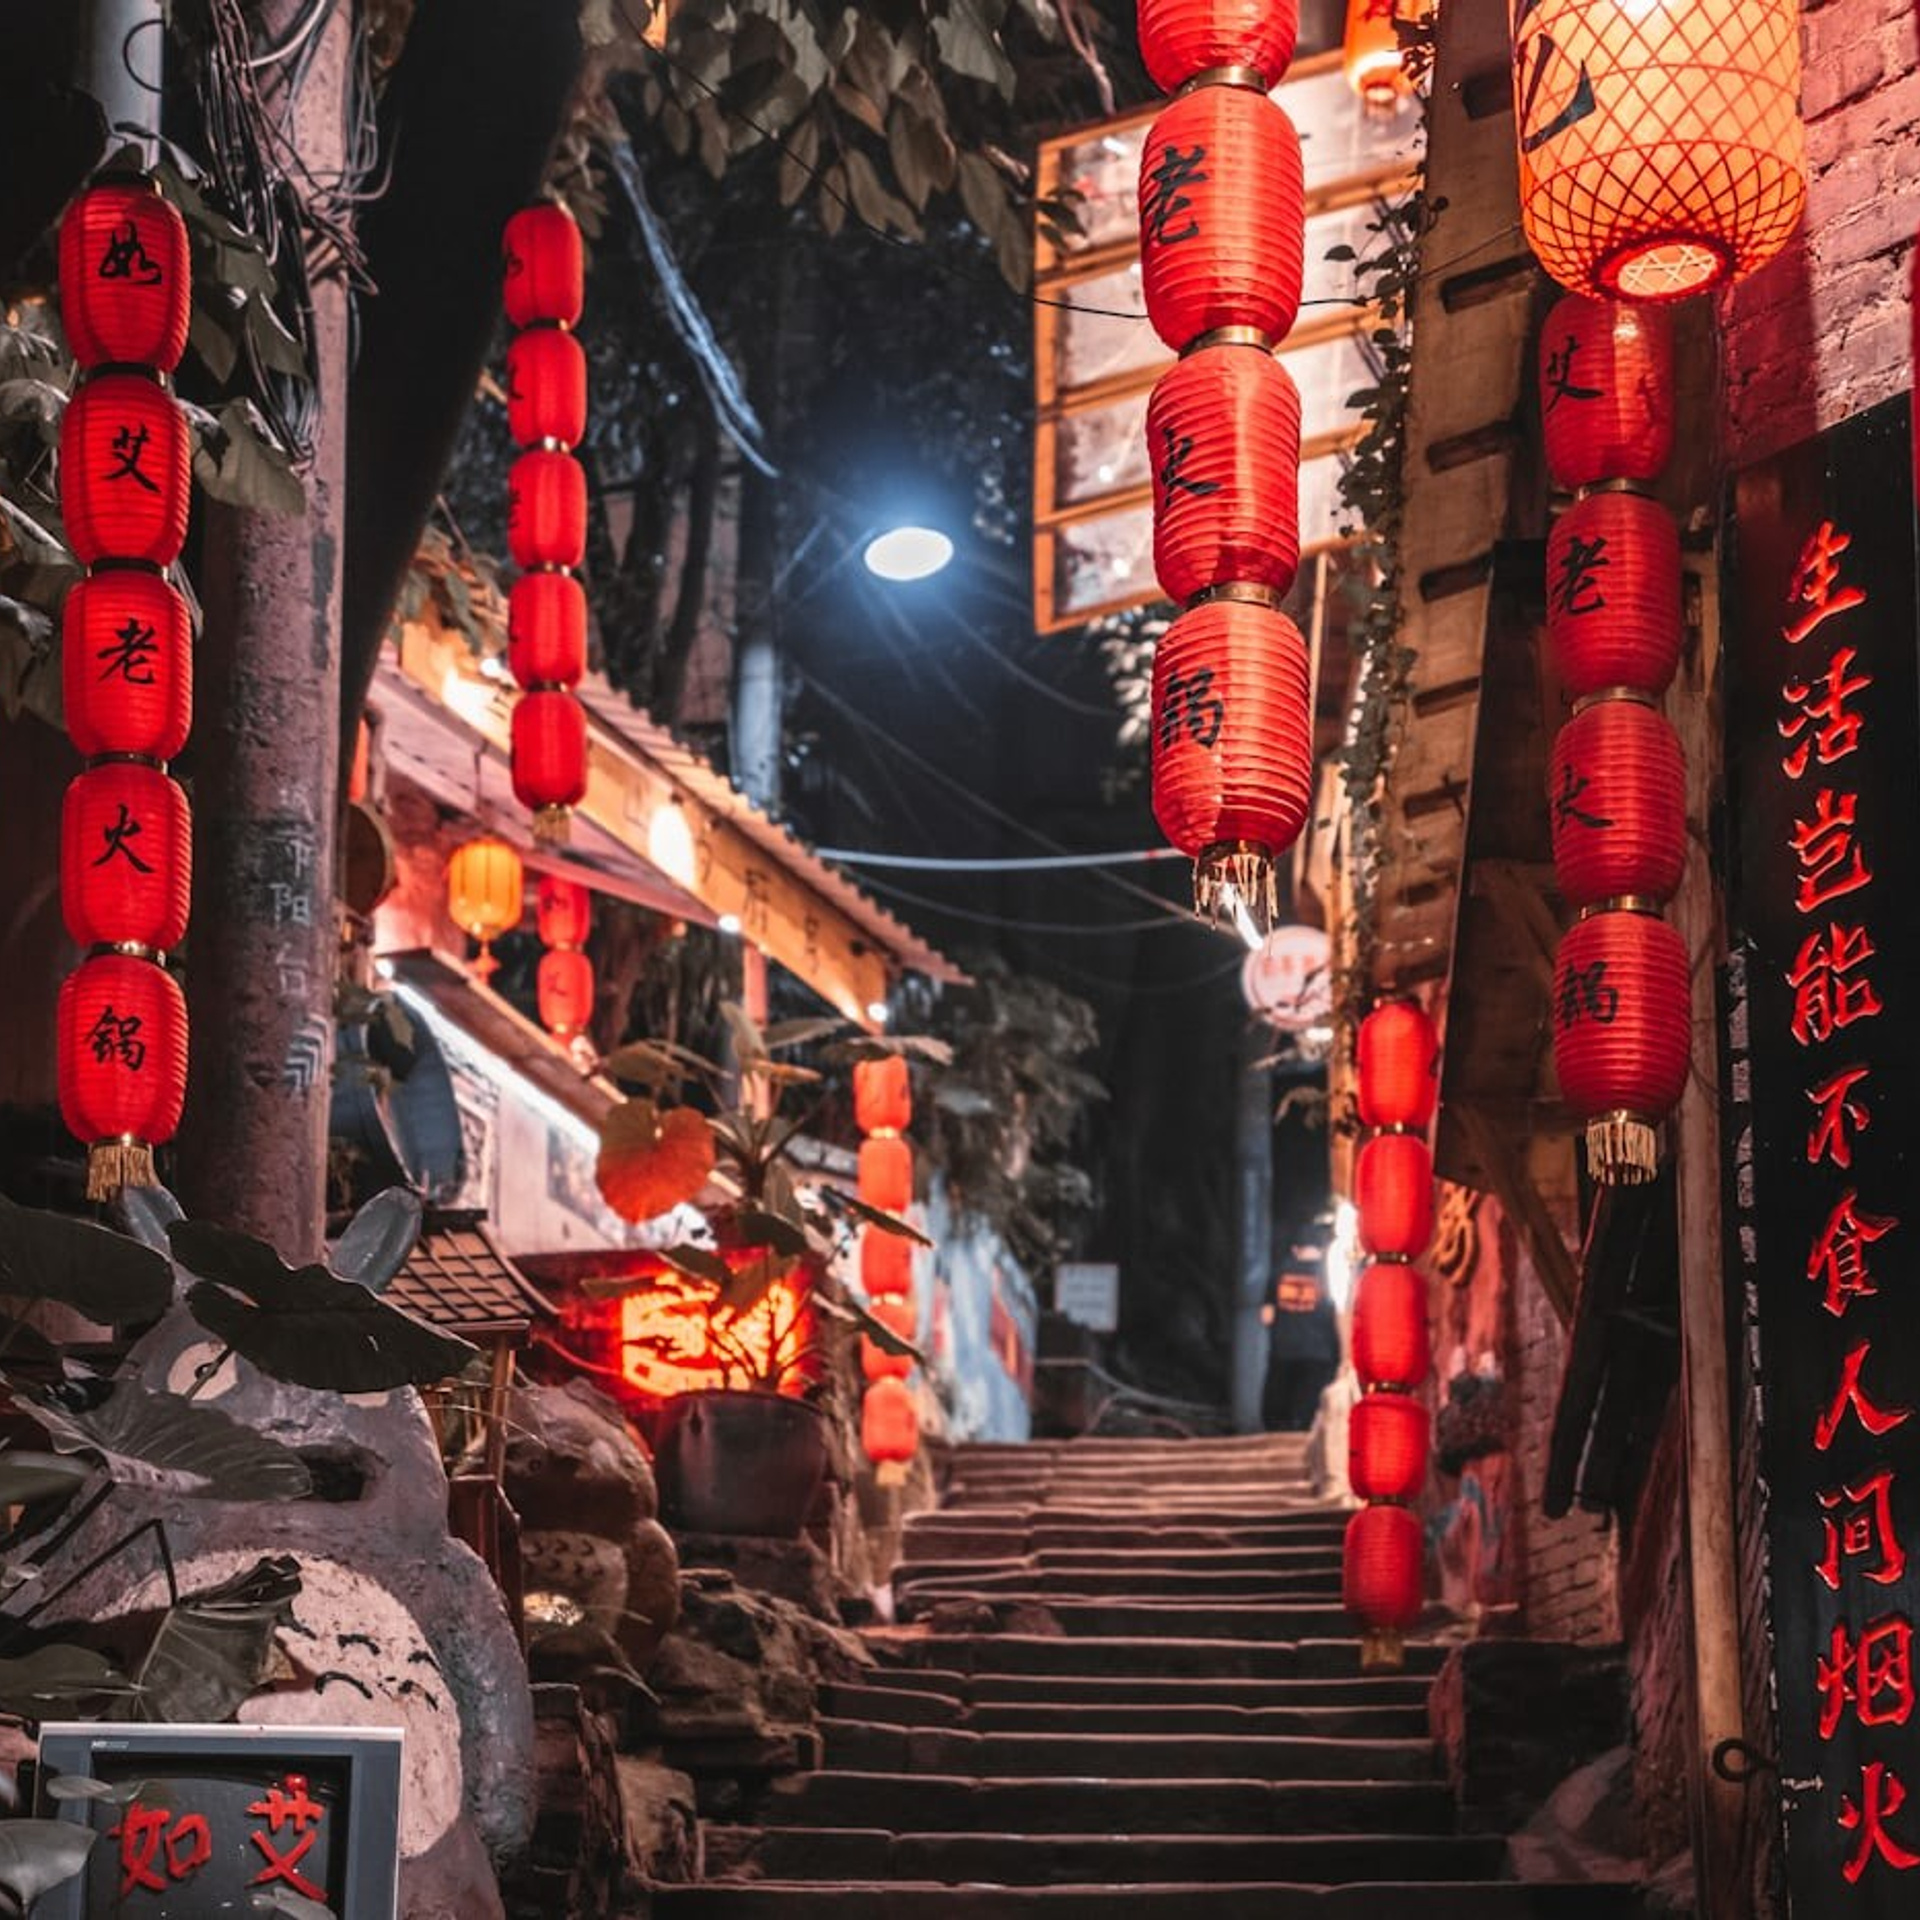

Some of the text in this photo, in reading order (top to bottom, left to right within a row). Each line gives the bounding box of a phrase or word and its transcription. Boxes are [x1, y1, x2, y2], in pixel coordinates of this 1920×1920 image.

[85, 219, 163, 1073] 如艾老火锅
[1141, 145, 1225, 750] 老火锅
[1777, 520, 1920, 1886] 生活岂能不食人间烟火
[109, 1786, 329, 1905] 如艾
